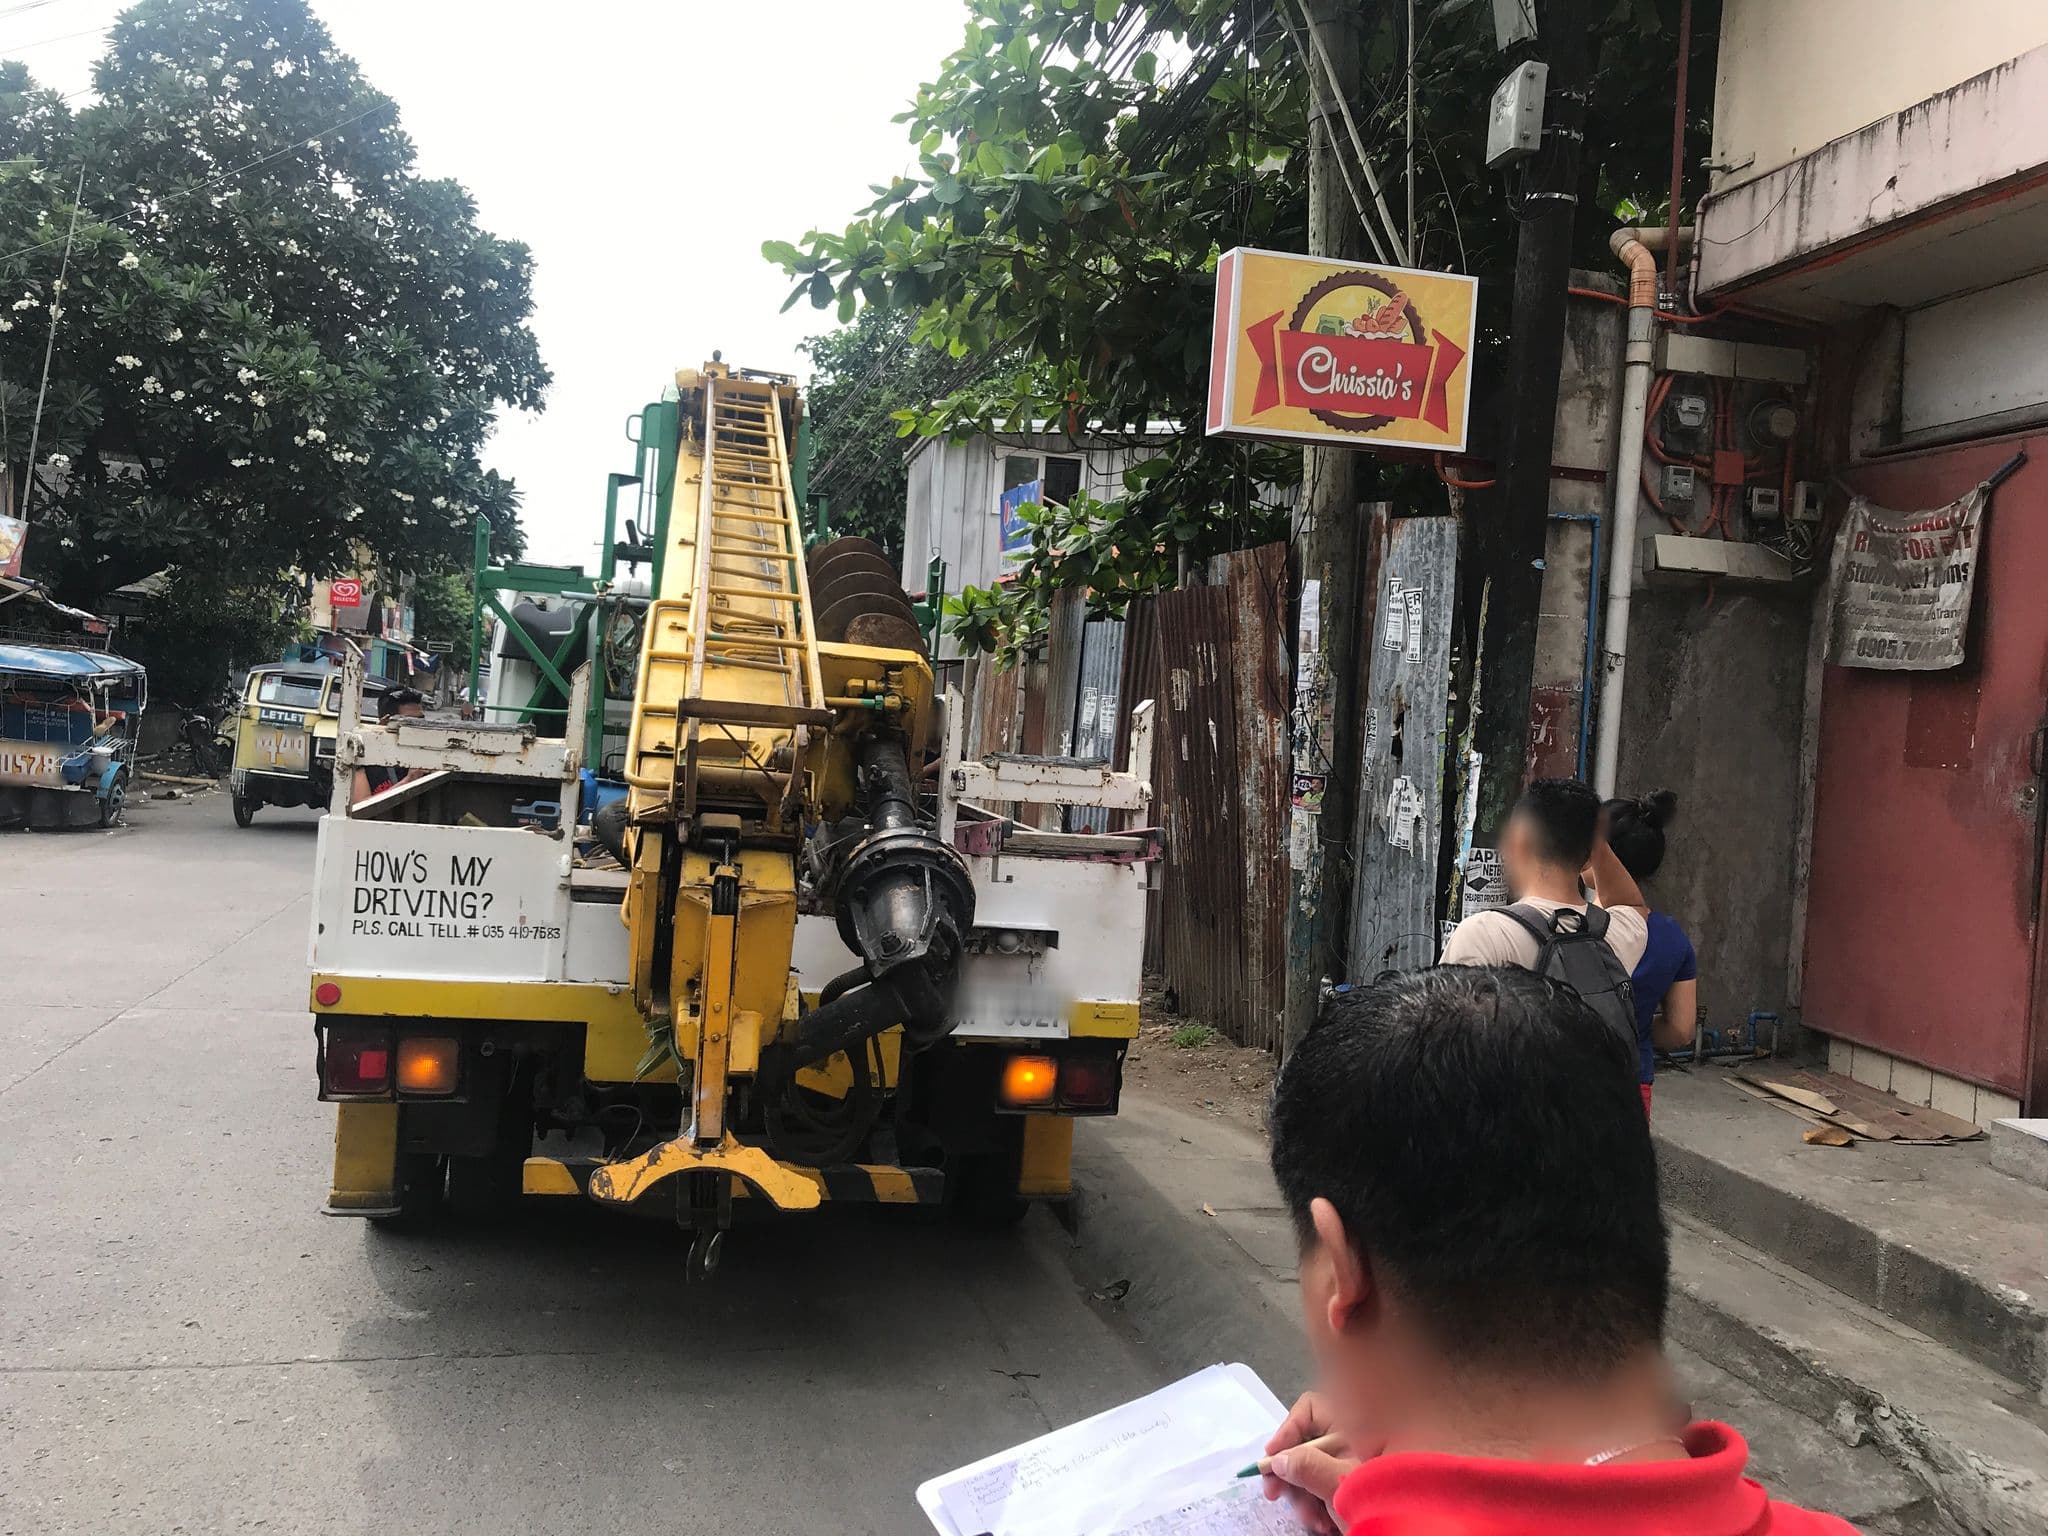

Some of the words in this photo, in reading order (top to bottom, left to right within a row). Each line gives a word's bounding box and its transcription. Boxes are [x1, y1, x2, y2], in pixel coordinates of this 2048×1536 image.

[1297, 346, 1412, 401] Chrissia's
[261, 709, 304, 723] LETLET
[354, 849, 428, 884] HOW'S
[450, 855, 493, 887] MY
[353, 887, 494, 919] DRIVING?
[352, 920, 384, 935] PLS.
[388, 921, 424, 937] CALL
[482, 925, 504, 938] 035
